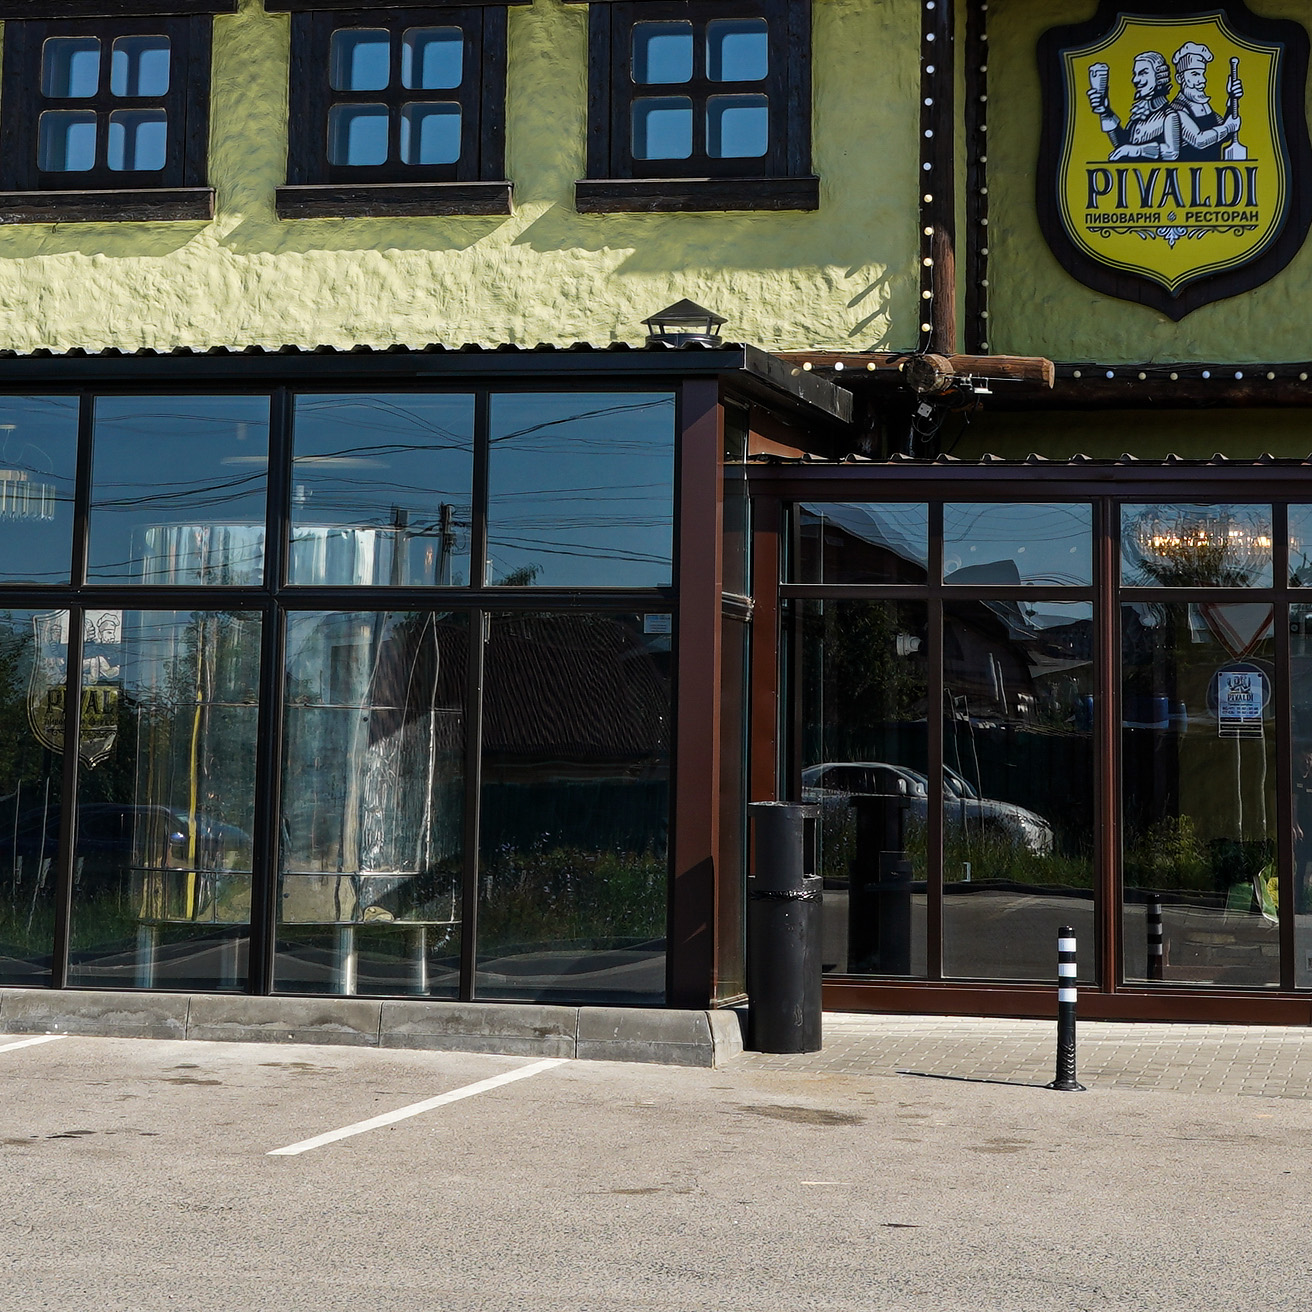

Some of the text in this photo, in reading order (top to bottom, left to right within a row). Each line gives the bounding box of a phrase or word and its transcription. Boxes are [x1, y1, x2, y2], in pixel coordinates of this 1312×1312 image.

[1085, 166, 1259, 209] PIVALDI
[1085, 210, 1259, 224] ПИВОВАРНЯ РЕСТОРАН
